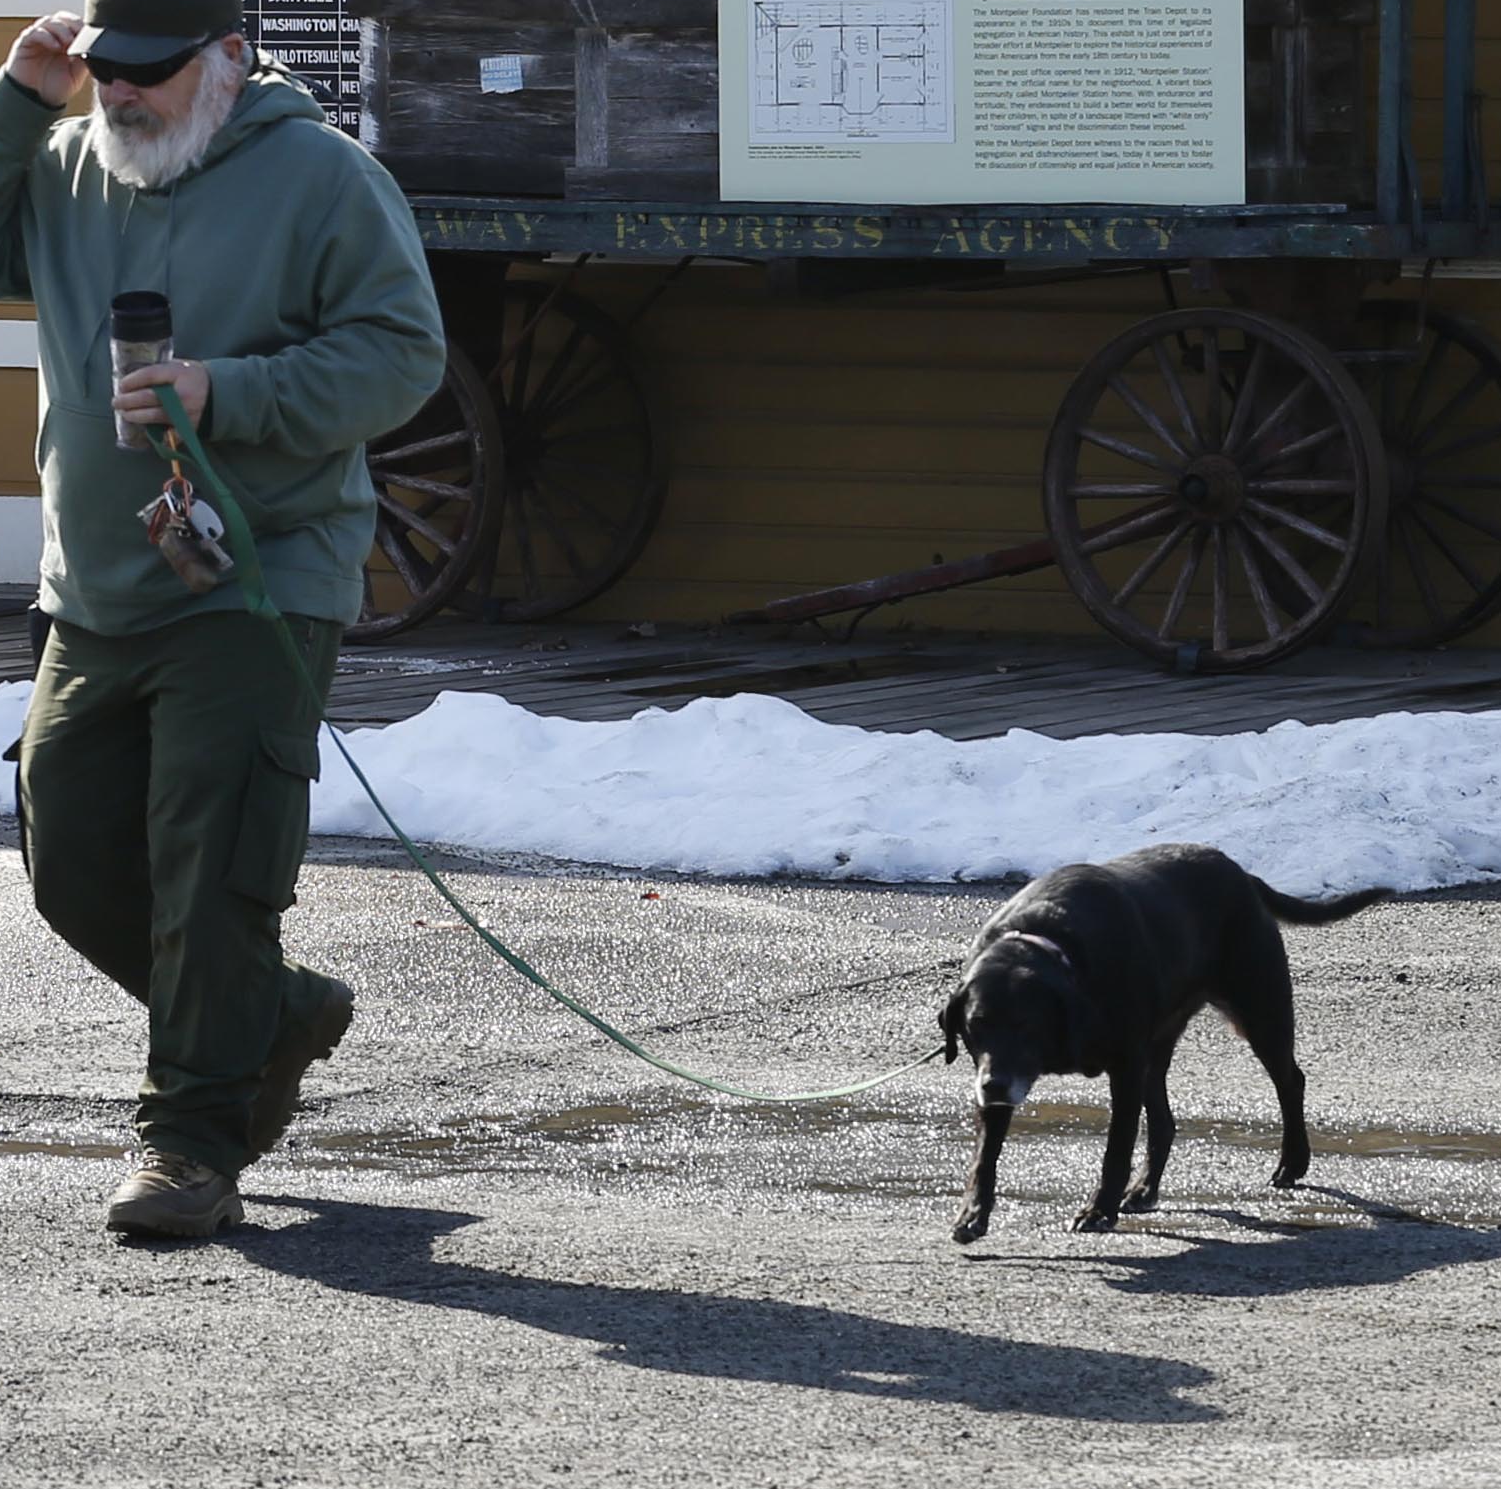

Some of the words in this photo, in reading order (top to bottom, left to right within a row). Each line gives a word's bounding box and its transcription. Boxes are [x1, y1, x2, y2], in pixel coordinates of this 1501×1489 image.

[262, 18, 336, 32] WASHINGTON
[269, 50, 338, 64] ARLOTTESVILLE
[615, 213, 884, 250] EXPRESS
[933, 217, 1180, 254] AGENCY
